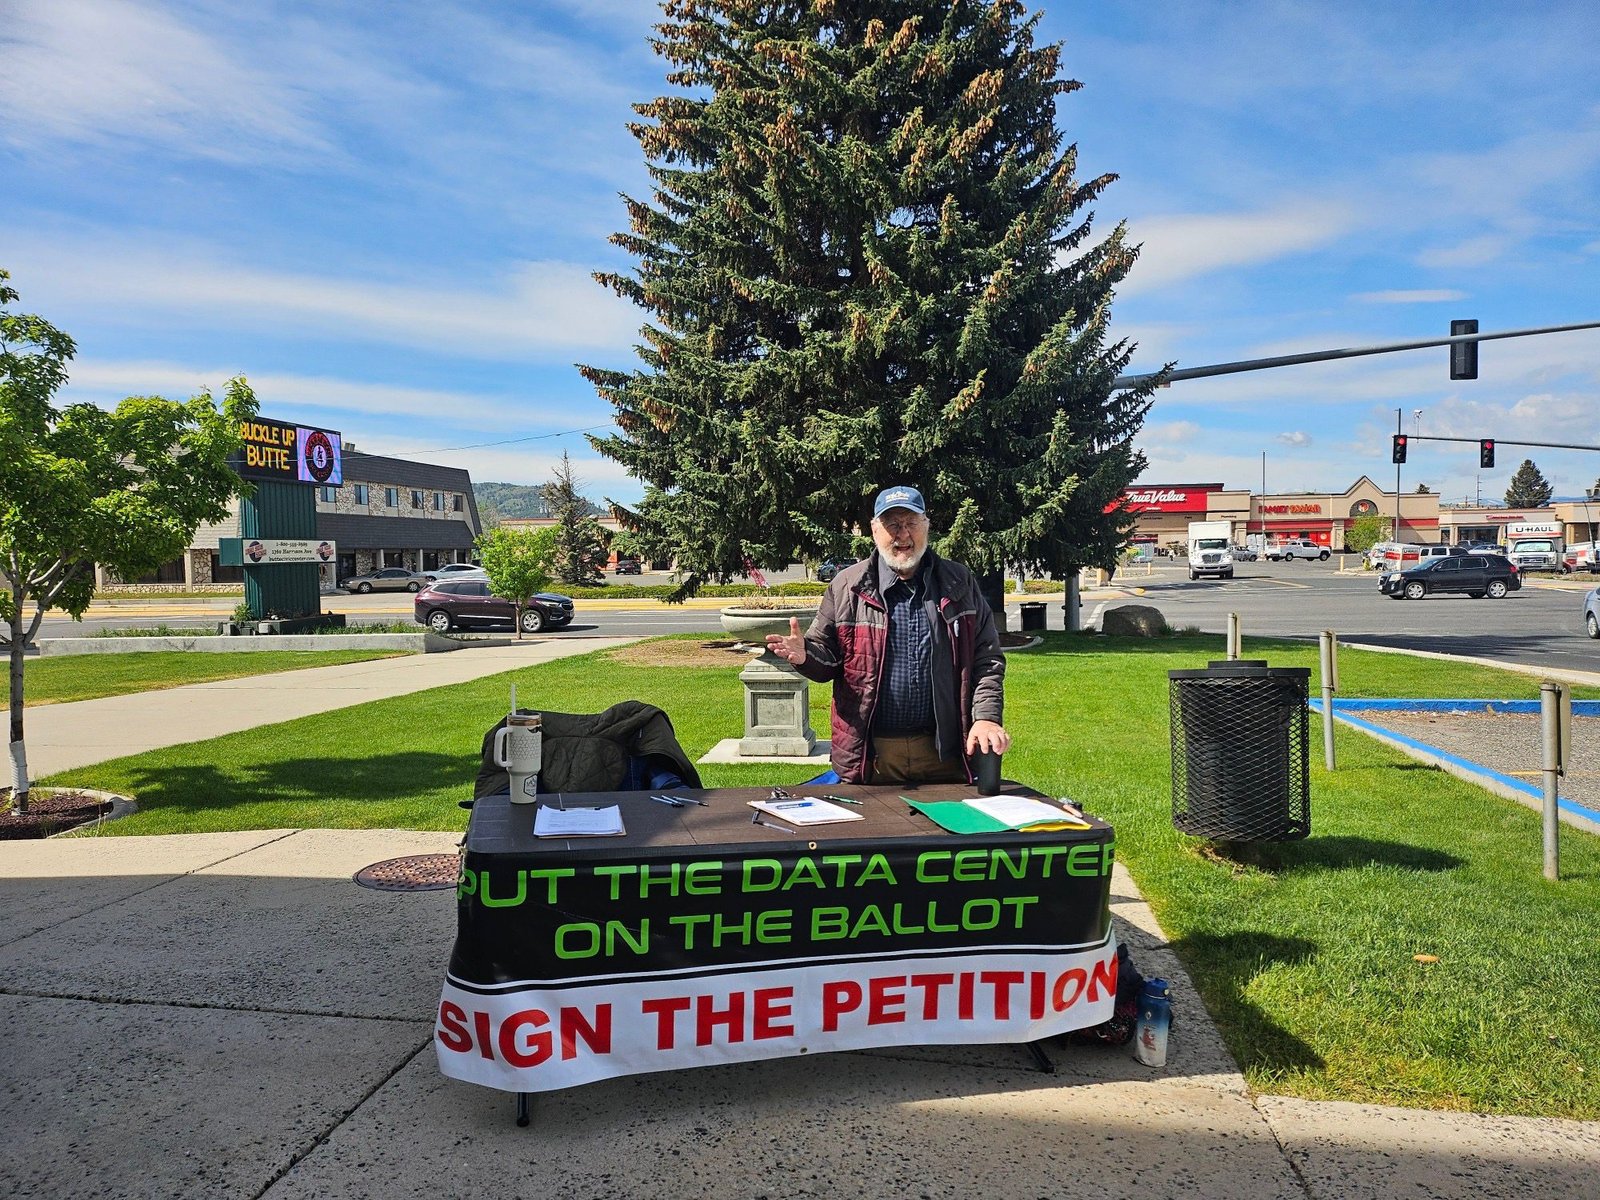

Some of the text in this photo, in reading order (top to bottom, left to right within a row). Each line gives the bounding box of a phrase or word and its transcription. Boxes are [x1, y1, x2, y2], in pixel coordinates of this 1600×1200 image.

[240, 422, 295, 447] BUCKLE UP
[247, 444, 290, 471] BUTTE
[457, 868, 576, 908] PUT
[593, 863, 724, 900] THE
[741, 857, 898, 893] DATA
[554, 896, 1040, 960] ON THE BALLOT
[437, 951, 1119, 1069] SIGN THE PETITION
